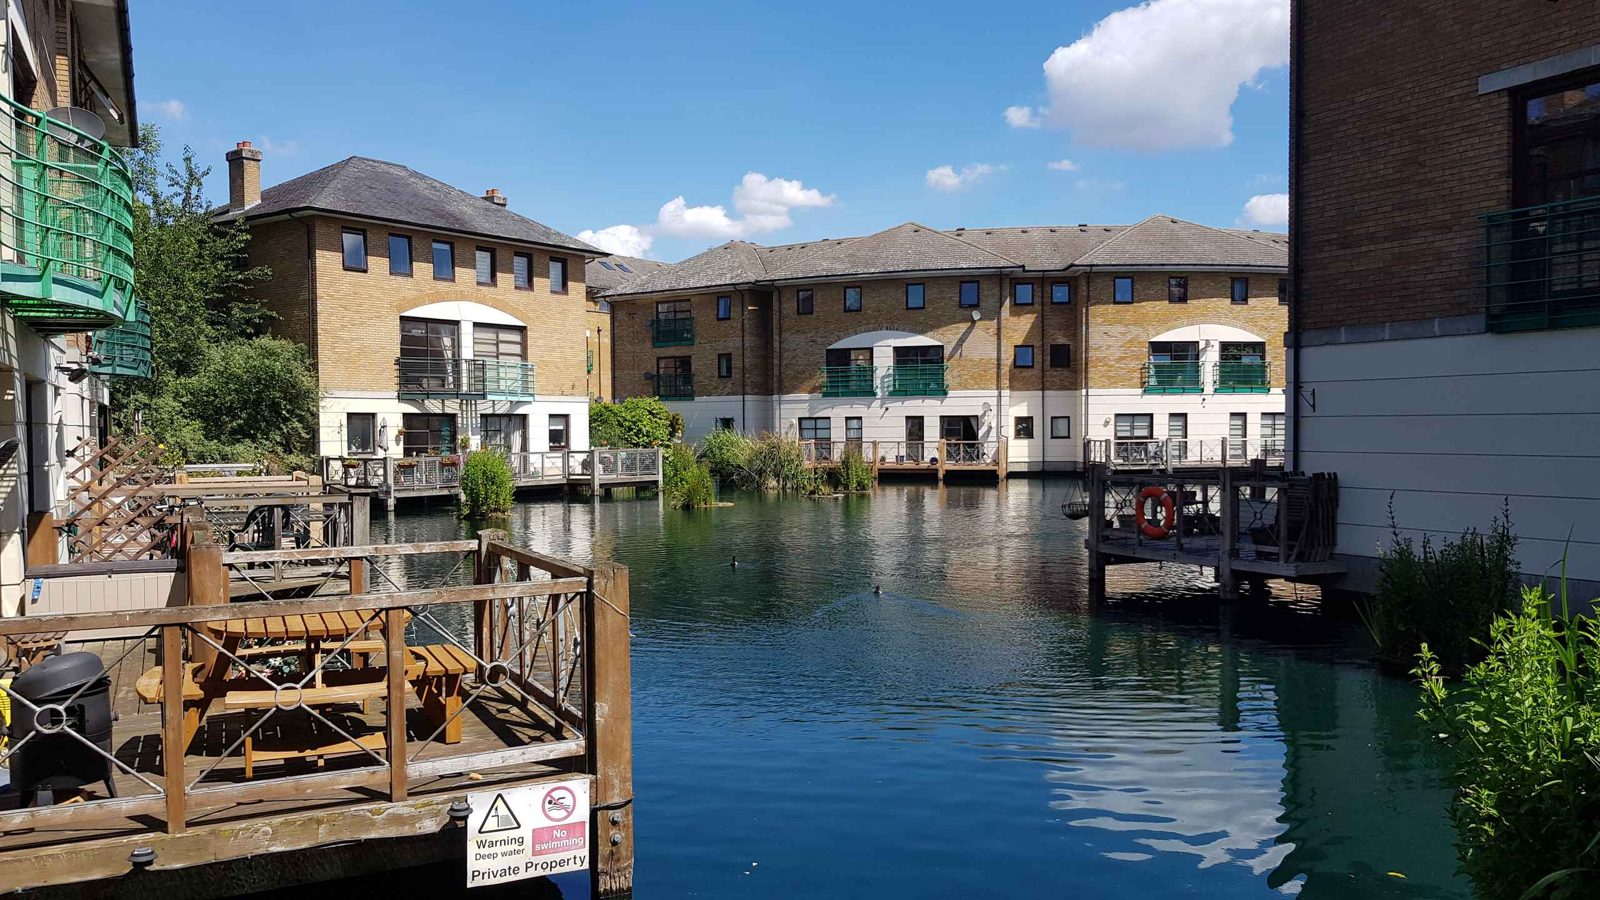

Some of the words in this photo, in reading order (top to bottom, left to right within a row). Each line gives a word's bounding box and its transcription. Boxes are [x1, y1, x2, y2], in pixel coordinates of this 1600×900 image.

[553, 829, 567, 838] No
[476, 835, 524, 850] Warning
[535, 836, 584, 851] swimming
[475, 852, 499, 861] Deep
[501, 847, 525, 858] water
[471, 864, 520, 881] Private
[525, 855, 586, 872] Property
